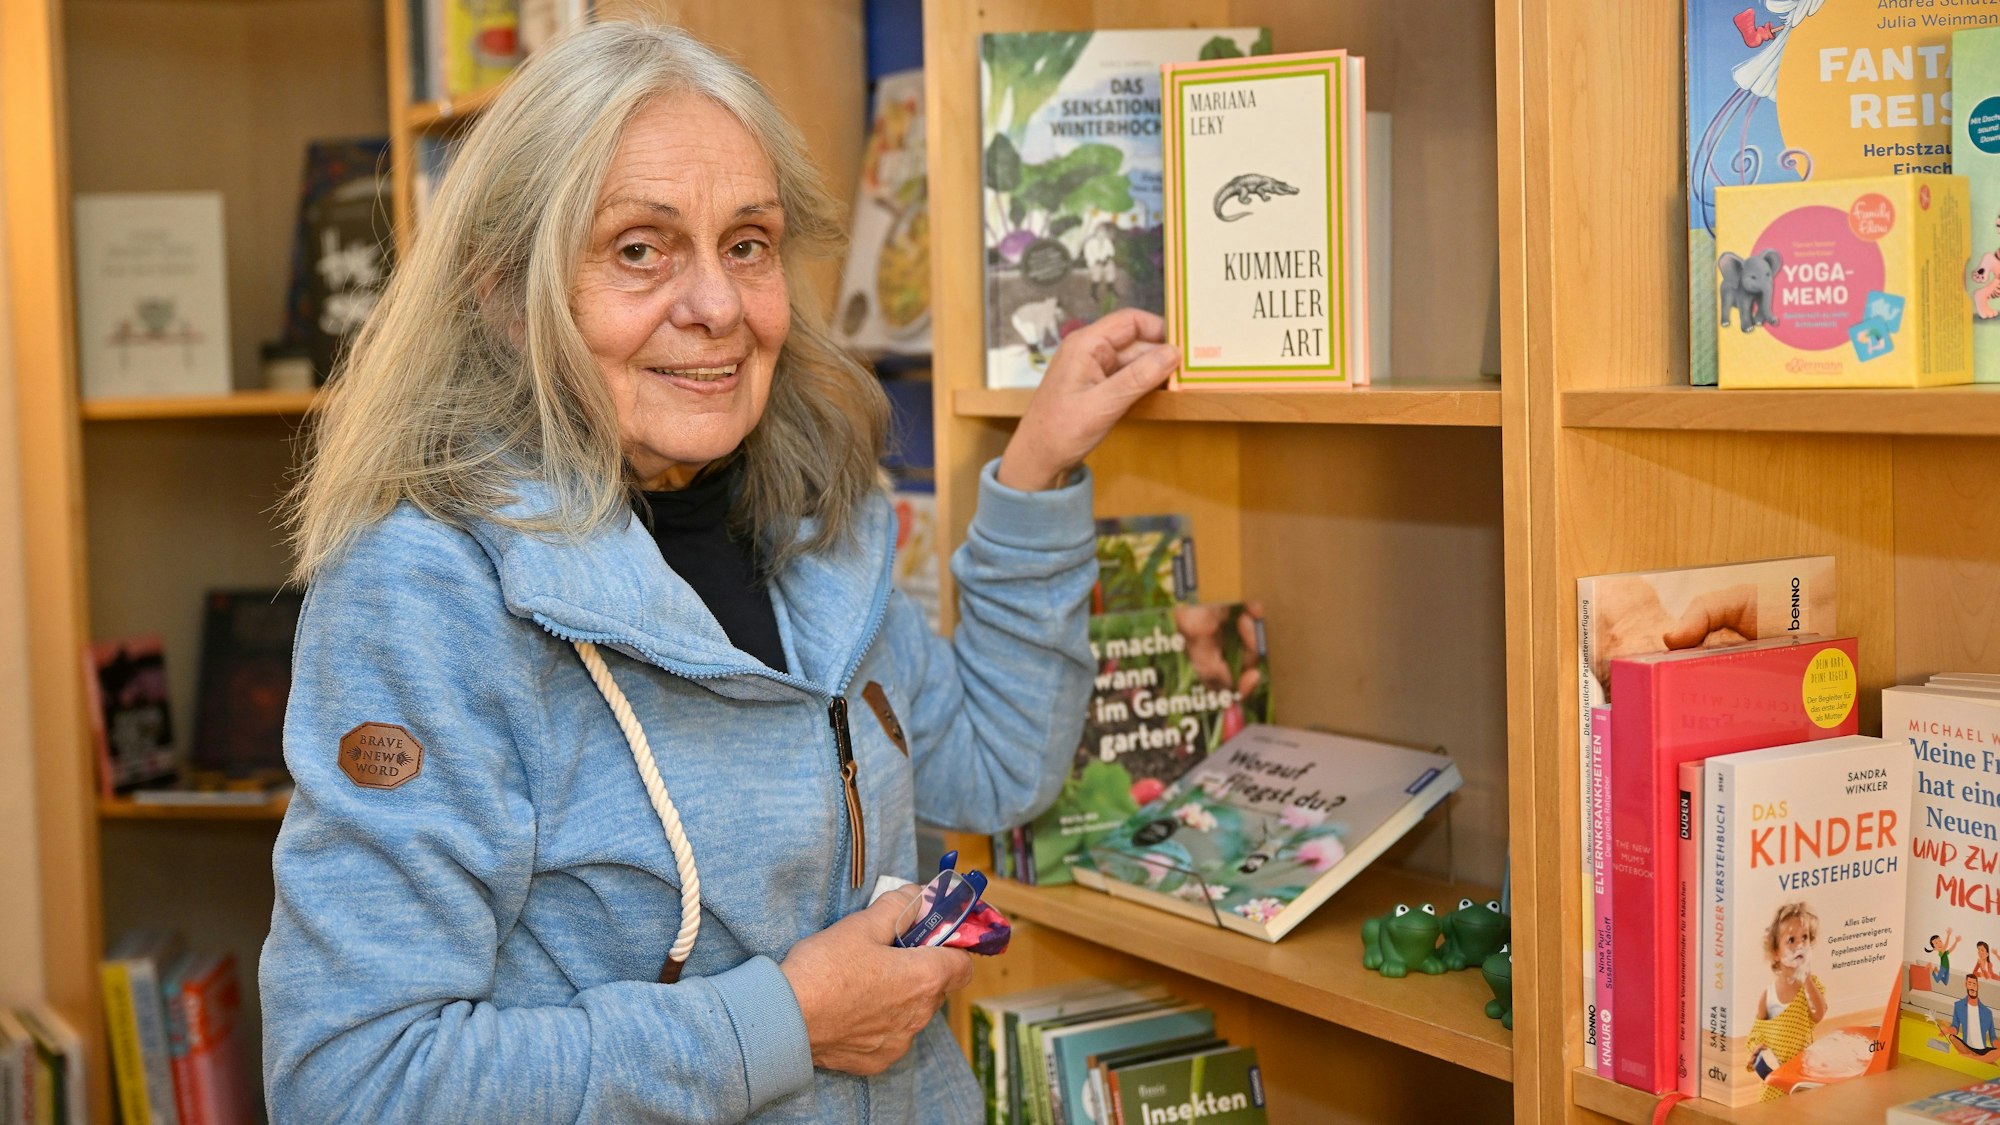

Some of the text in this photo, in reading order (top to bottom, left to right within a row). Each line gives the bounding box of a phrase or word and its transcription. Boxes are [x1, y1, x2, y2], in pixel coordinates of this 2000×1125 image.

[1877, 13, 1998, 29] Julia Weinman
[1819, 45, 1952, 82] FANT
[1111, 78, 1144, 94] DAS
[1190, 90, 1256, 112] MARIANA
[1191, 115, 1224, 136] LEKY
[1224, 249, 1323, 281] KUMMER
[1783, 262, 1854, 283] YOGA-
[1252, 288, 1324, 319] ALLER
[1782, 286, 1848, 306] MEMO
[1281, 328, 1323, 357] ART
[1106, 626, 1185, 658] mache
[1816, 658, 1829, 670] DEIN
[1095, 668, 1157, 690] wann
[1811, 670, 1848, 684] DEINE REGELN
[1095, 685, 1242, 723] im Gemüse-
[1807, 691, 1852, 704] Der Begleiter für
[1810, 702, 1847, 713] das erste Jahr
[1815, 712, 1843, 722] als Mutter
[361, 734, 403, 749] BRAVE
[1100, 716, 1199, 762] garten?
[1908, 719, 1984, 743] MICHAEL
[363, 750, 396, 763] NEW
[1909, 737, 1976, 770] Meine
[356, 763, 399, 777] WORD
[1229, 750, 1316, 781] Worauf
[1847, 768, 1887, 782] SANDRA
[1604, 776, 1612, 813] Ratgeber
[1846, 781, 1888, 795] WINKLER
[1918, 770, 1955, 799] hat
[1293, 789, 1346, 812] du?
[1752, 800, 1788, 821] DAS
[1593, 735, 1604, 895] ELTERNKRANKHEITEN
[1681, 799, 1689, 839] DUDEN
[1926, 806, 1998, 841] Neuen
[1615, 839, 1651, 854] THE NEW
[1750, 809, 1897, 869] KINDER
[1621, 853, 1646, 865] MUM'S
[1912, 837, 2000, 875] UND ZW
[1613, 863, 1655, 879] NOTEBOOK
[1779, 856, 1898, 891] VERSTEHBUCH
[928, 915, 941, 928] LOT
[1844, 916, 1876, 927] Alles über
[1828, 927, 1893, 944] Gemüseverweigerer,
[1831, 939, 1888, 957] Popelmonster und
[1605, 950, 1613, 989] Susanne
[1832, 954, 1886, 970] Matratzenhüpfer
[1715, 963, 1723, 990] DAS
[1710, 1006, 1718, 1048] SANDRA
[1719, 1007, 1727, 1052] WINKLER
[1602, 1024, 1612, 1067] KNAUR
[1868, 1039, 1886, 1053] dtv
[1708, 1066, 1727, 1083] dtv
[1141, 1092, 1248, 1125] Insekten
